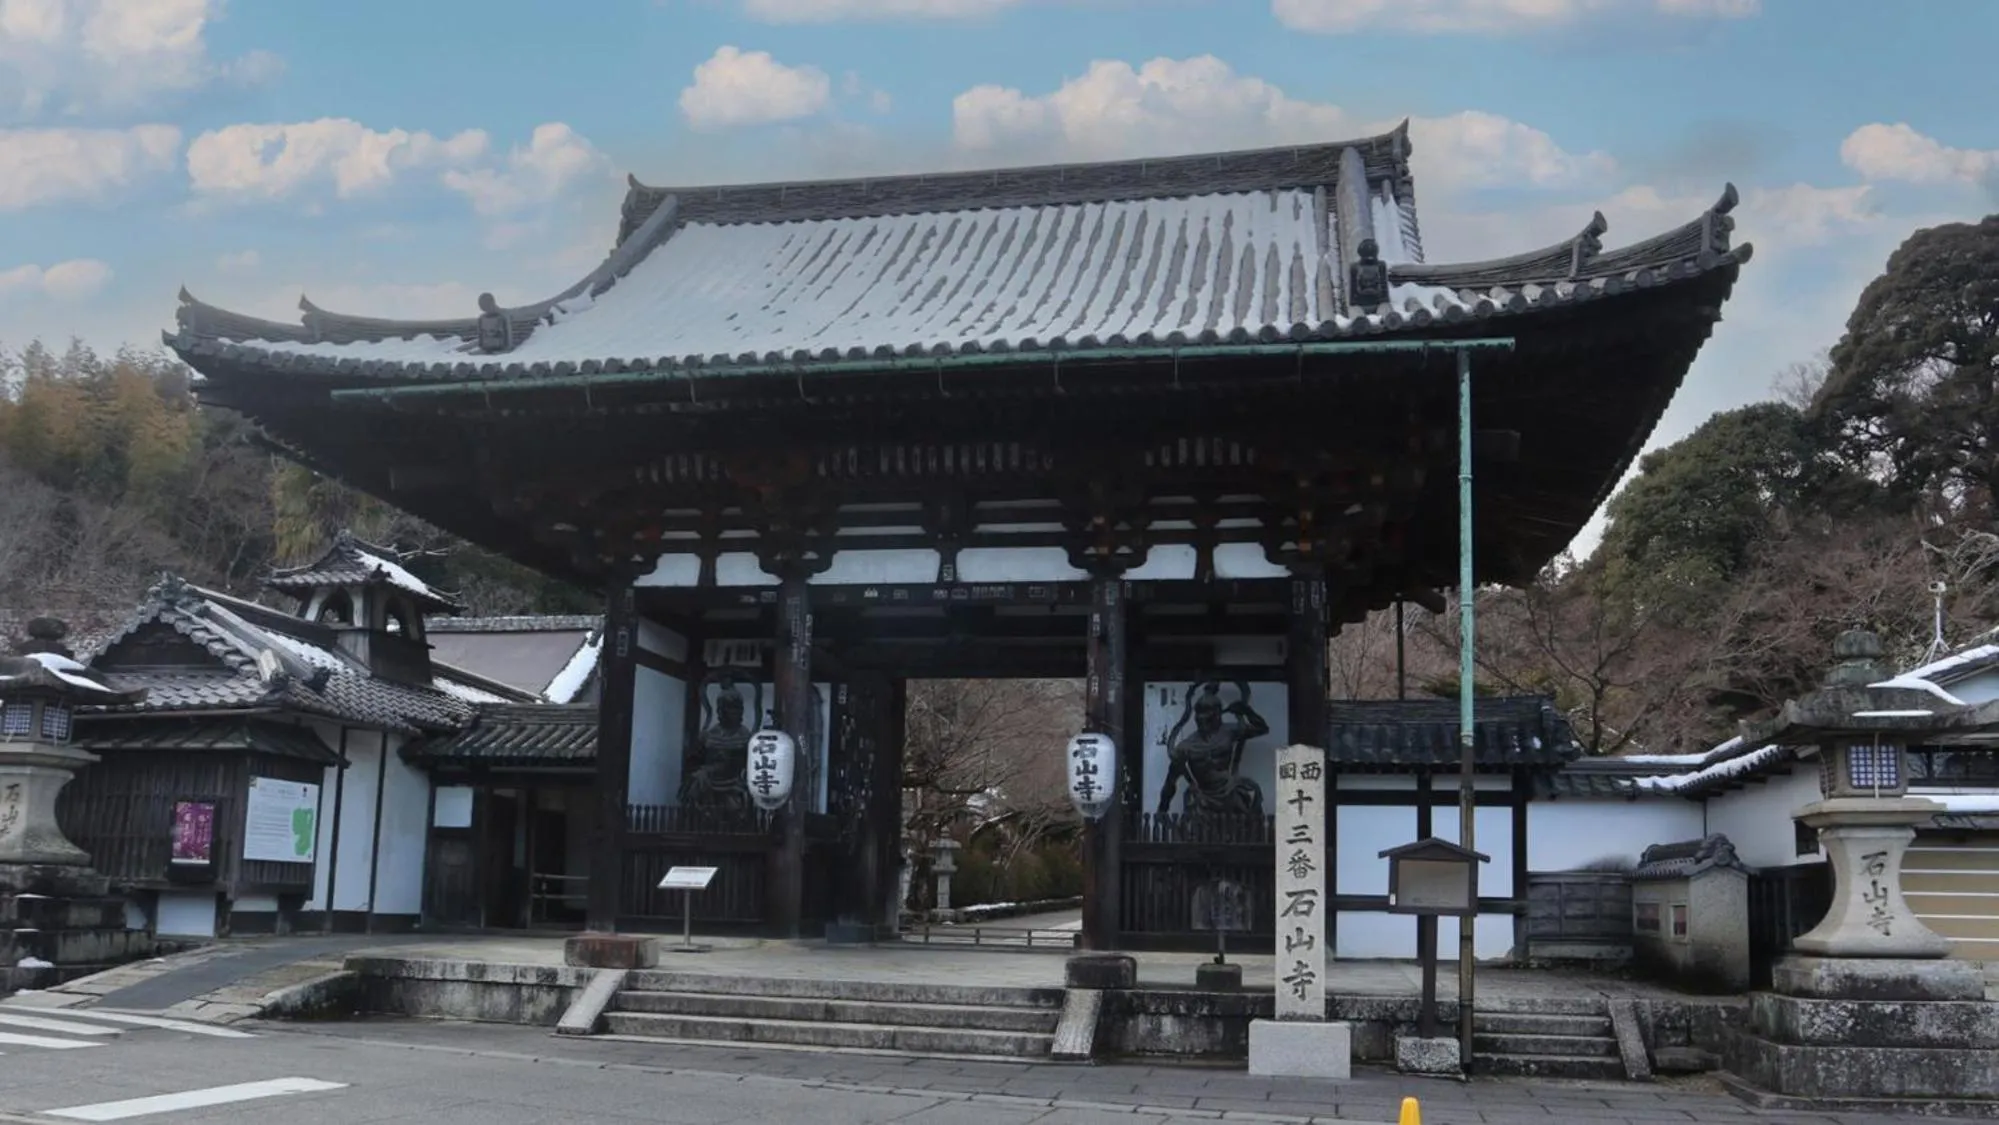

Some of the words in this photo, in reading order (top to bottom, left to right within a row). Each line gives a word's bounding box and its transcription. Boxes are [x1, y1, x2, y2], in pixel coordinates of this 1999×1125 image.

[753, 735, 780, 796] 石山寺
[1072, 738, 1103, 801] 石山寺
[1859, 850, 1895, 936] 石山寺
